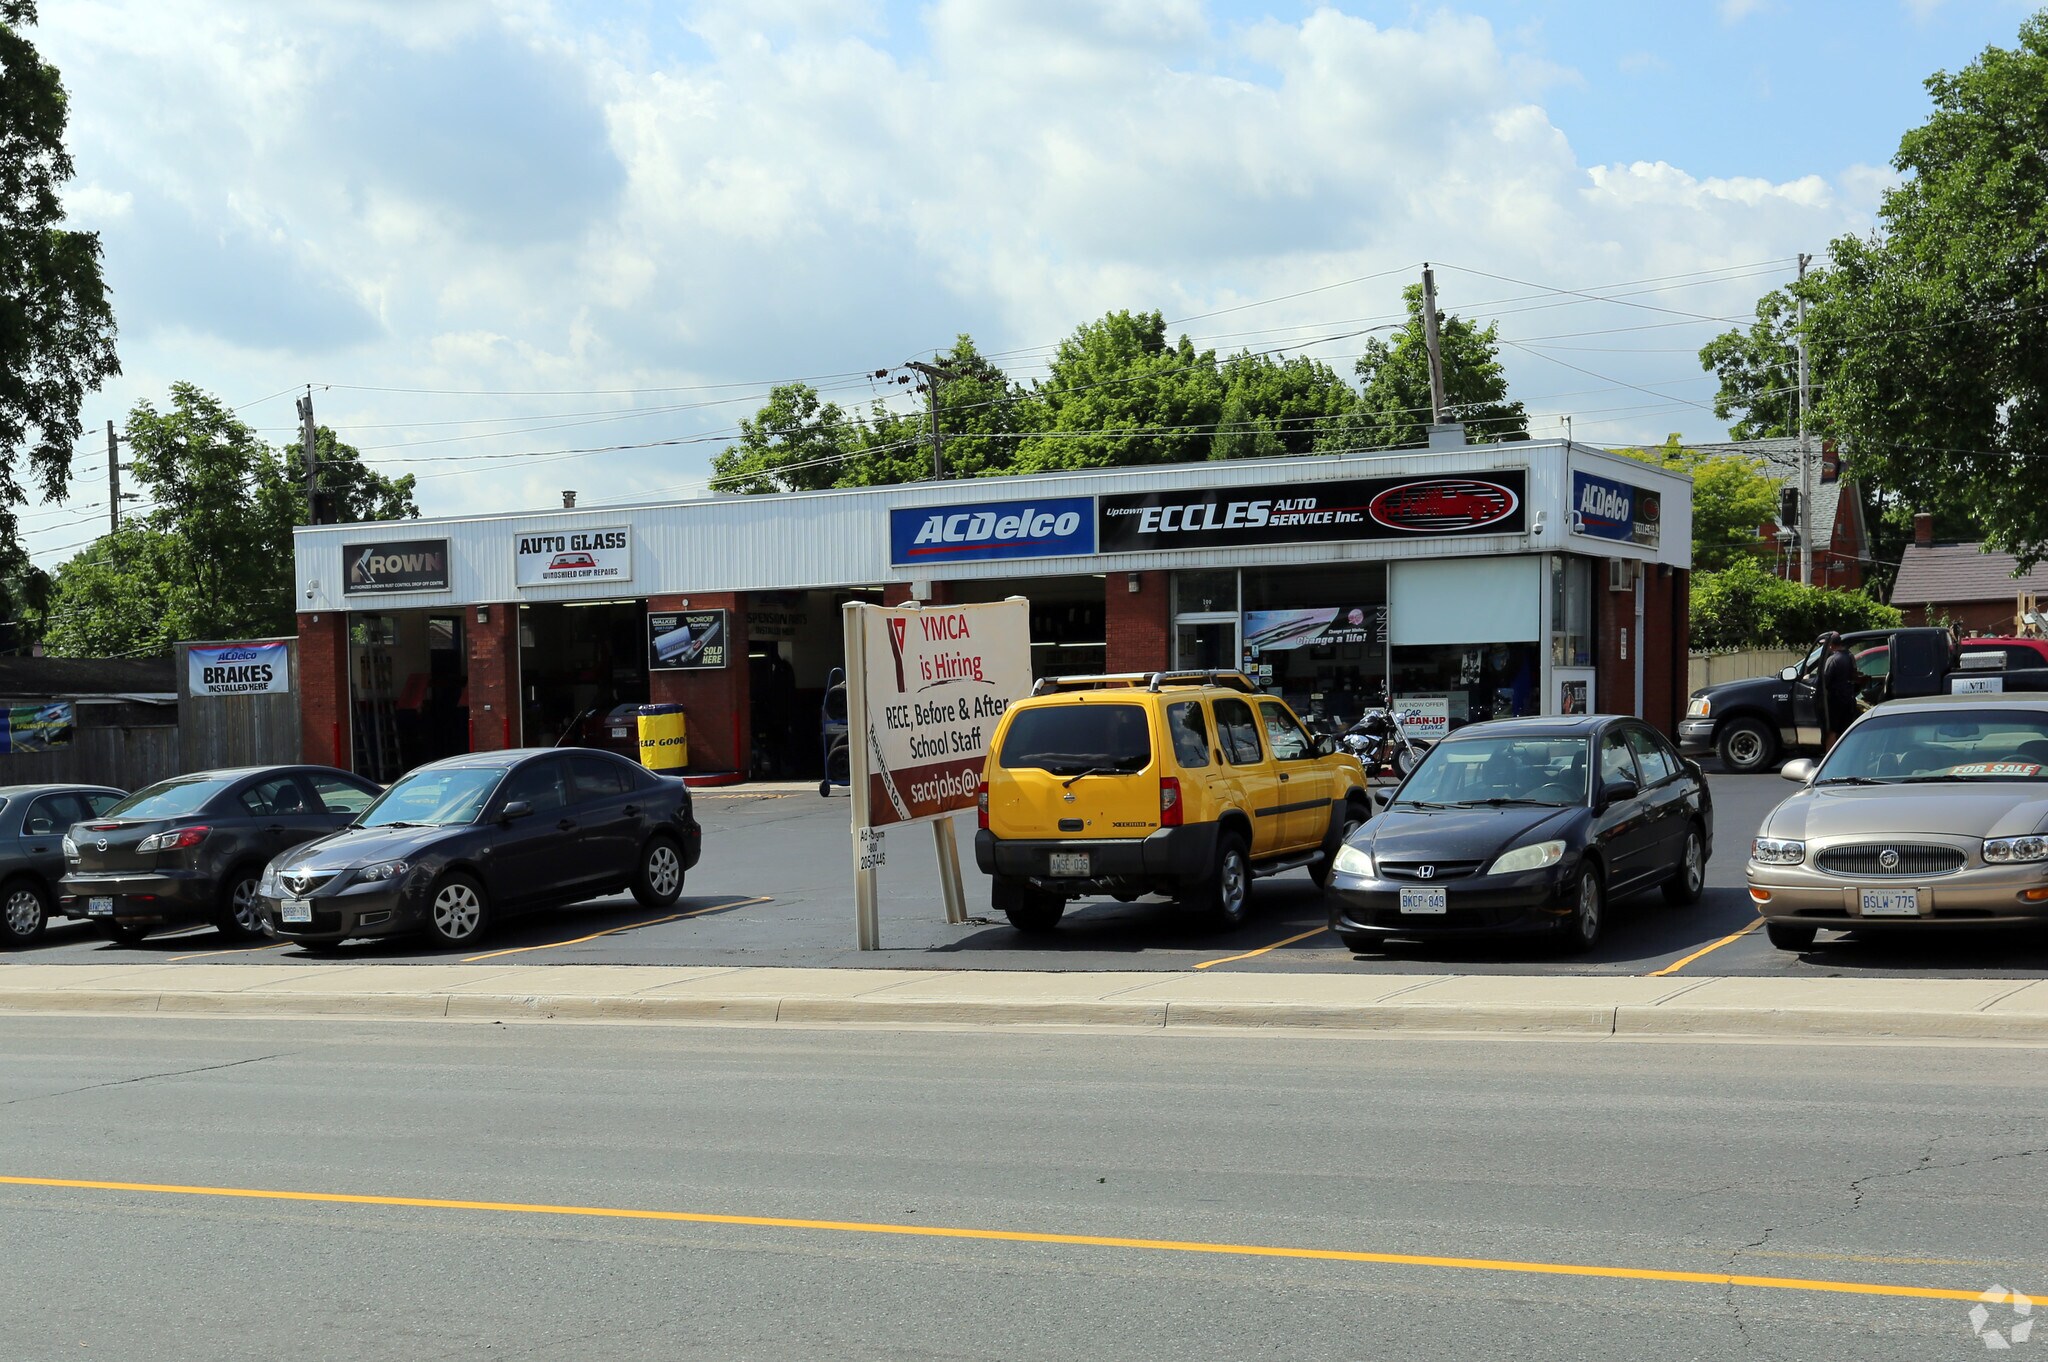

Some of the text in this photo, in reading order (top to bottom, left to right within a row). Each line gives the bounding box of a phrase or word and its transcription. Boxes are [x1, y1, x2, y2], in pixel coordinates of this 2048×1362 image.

[1273, 498, 1317, 511] AUTO
[1580, 483, 1629, 522] ACDelco
[913, 508, 1080, 545] ACDelco
[1106, 500, 1363, 534] Uptown ECCLES SERVICE Inc.
[519, 532, 626, 555] AUTO GLASS
[351, 548, 441, 584] KROWN
[543, 568, 618, 579] WINDSHIELD CHIP REPAIRS
[920, 614, 970, 641] YMCA
[1296, 636, 1334, 646] Change
[1345, 633, 1367, 642] life!
[217, 652, 257, 660] ACDelco
[702, 655, 722, 664] HERE
[703, 646, 723, 655] SOLD
[203, 664, 273, 684] BRAKES
[920, 651, 983, 681] is Hiring
[208, 682, 268, 692] INSTALLED HERE
[886, 695, 1009, 731] RECE, Before & After
[1403, 716, 1446, 724] LEAN-UP
[1405, 709, 1421, 717] CAR
[909, 726, 981, 759] School Staff
[869, 723, 891, 789] Resumes
[1952, 764, 2036, 774] FOR SALE
